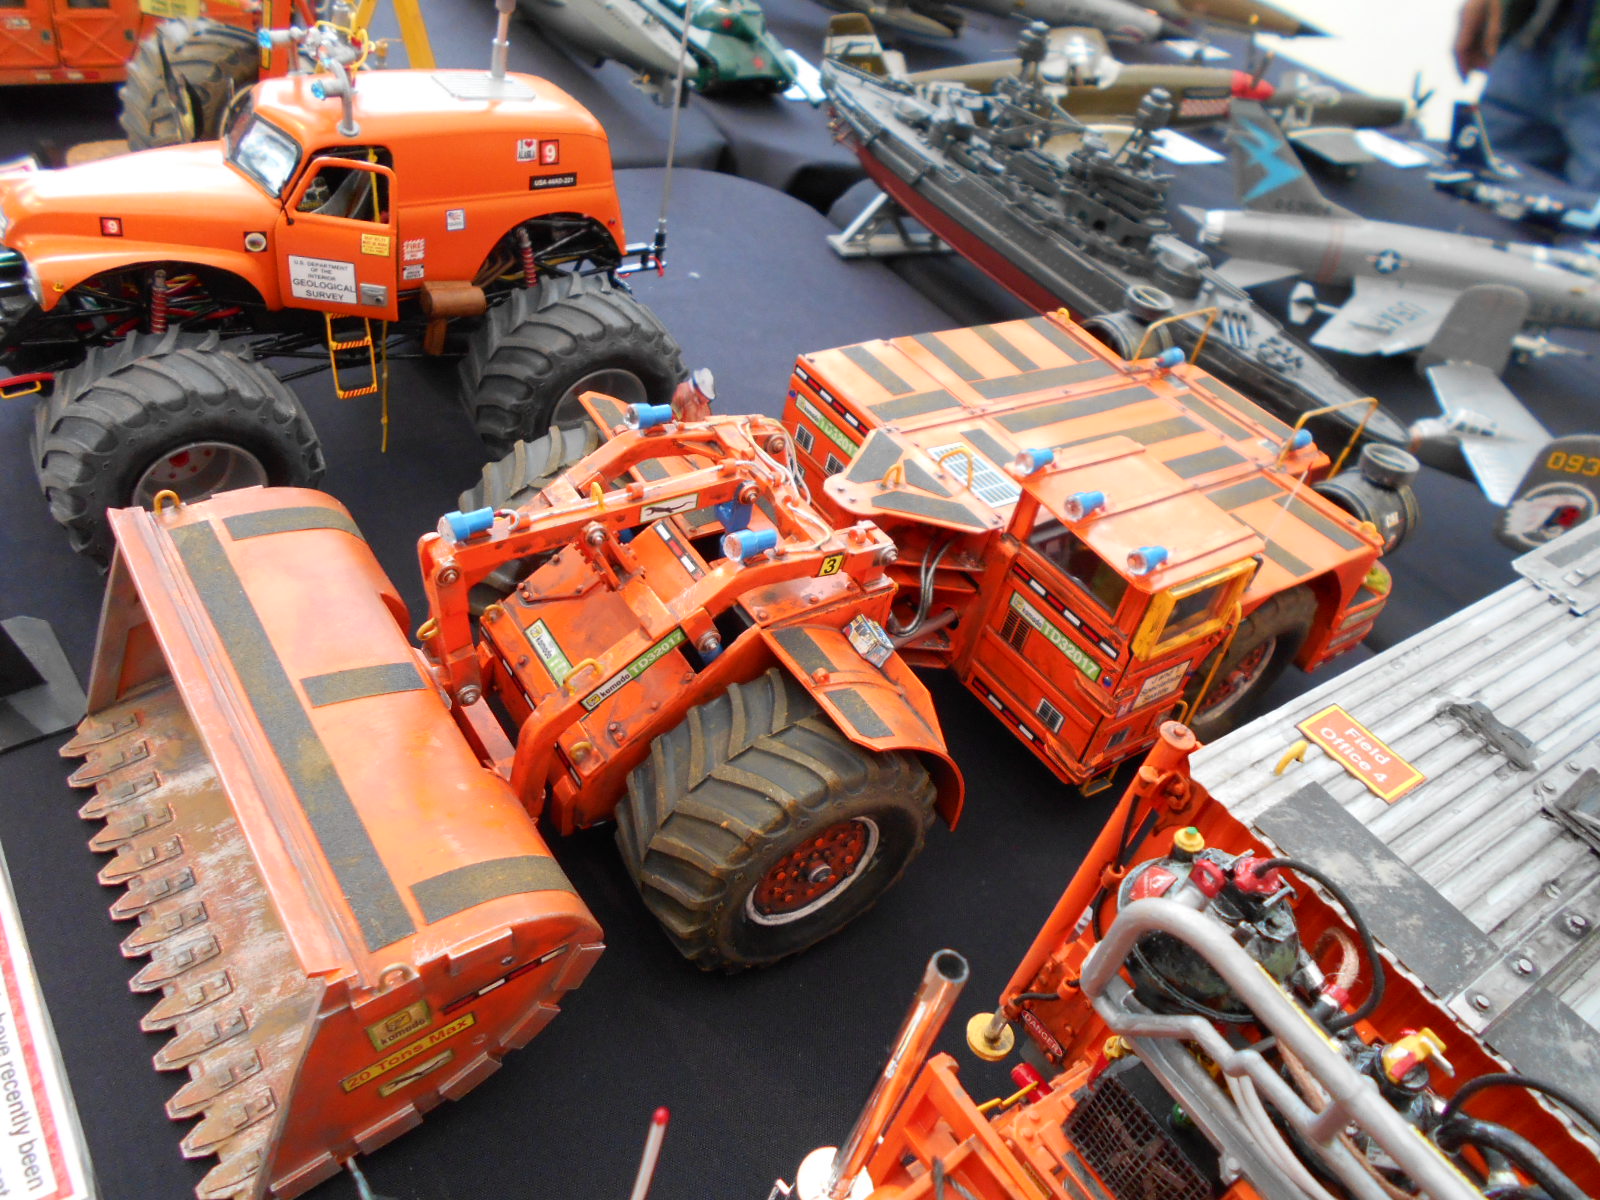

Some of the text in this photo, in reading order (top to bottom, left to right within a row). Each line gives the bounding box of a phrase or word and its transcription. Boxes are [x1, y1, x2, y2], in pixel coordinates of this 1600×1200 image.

[545, 144, 557, 163] 9
[108, 220, 119, 233] 9
[307, 261, 348, 271] DEPARTMENT
[307, 273, 337, 281] INTERIOR
[292, 278, 356, 294] GEOLOGICAL
[305, 289, 344, 301] SURVEY
[823, 558, 837, 574] 3
[1042, 621, 1099, 677] TD32017
[599, 631, 683, 698] komodo TD32017
[1319, 727, 1389, 783] Office 4
[1344, 727, 1391, 765] Field
[380, 1018, 427, 1046] komodo
[1024, 1013, 1060, 1051] DANGER
[347, 1019, 469, 1090] 20 Tons Max
[0, 1061, 32, 1137] recently
[18, 1138, 45, 1191] been
